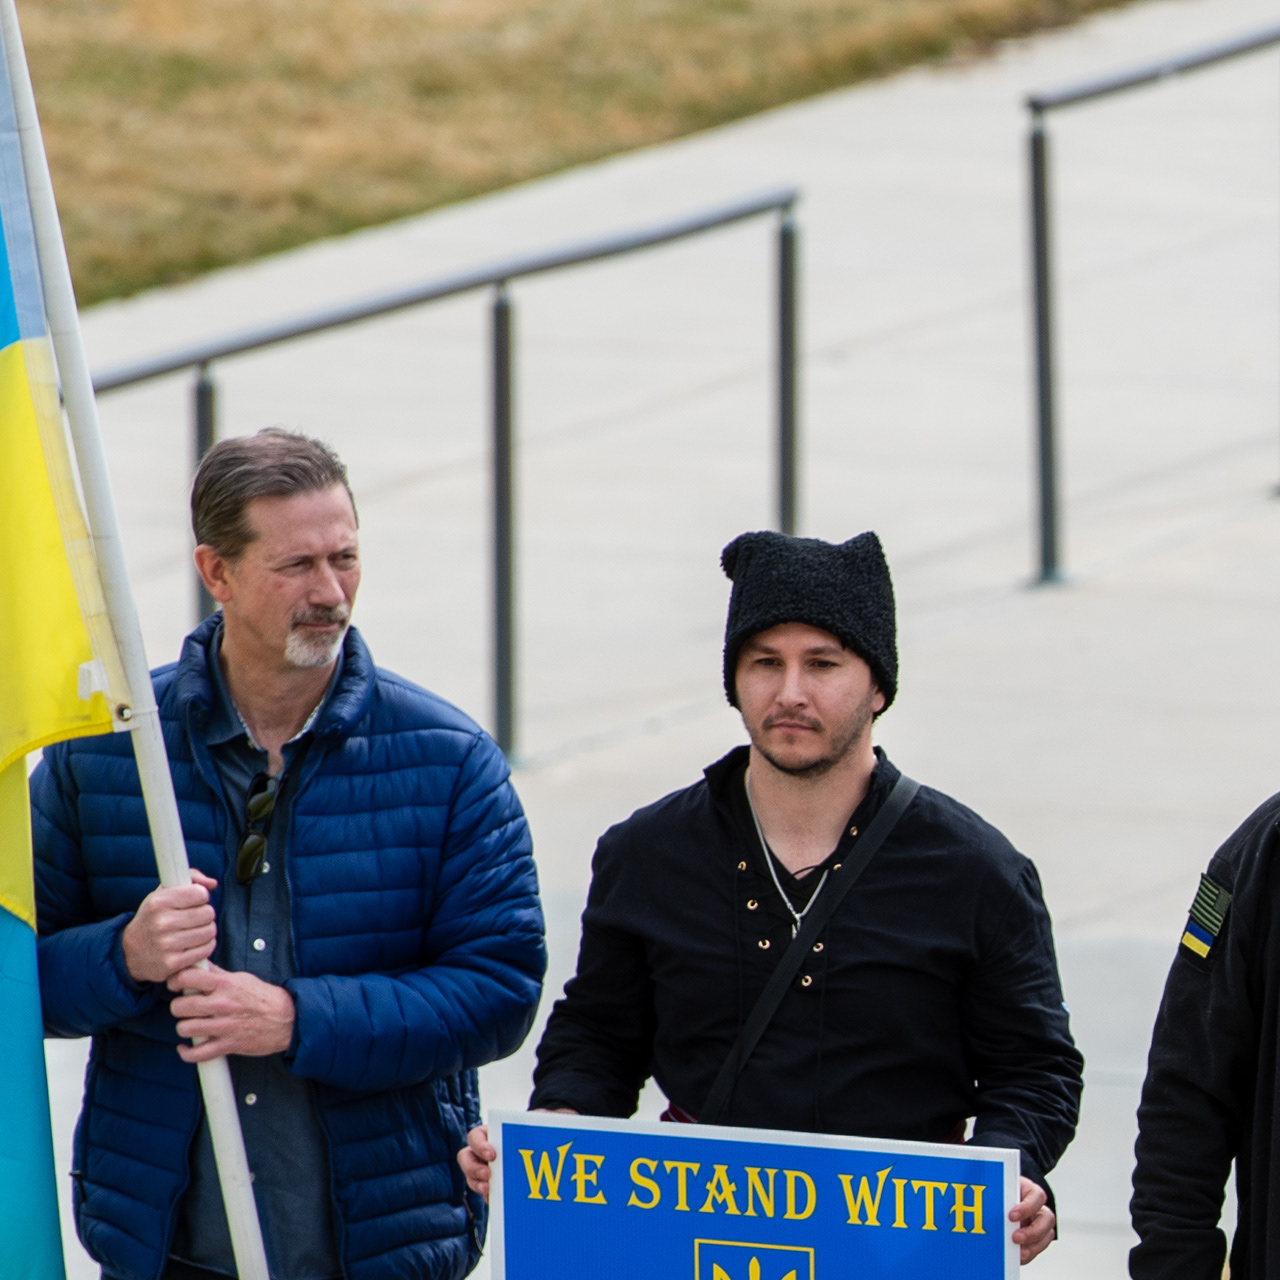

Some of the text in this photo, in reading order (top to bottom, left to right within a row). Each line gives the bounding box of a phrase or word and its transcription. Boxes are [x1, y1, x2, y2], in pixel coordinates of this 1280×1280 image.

[519, 1141, 987, 1235] WE STAND WITH
